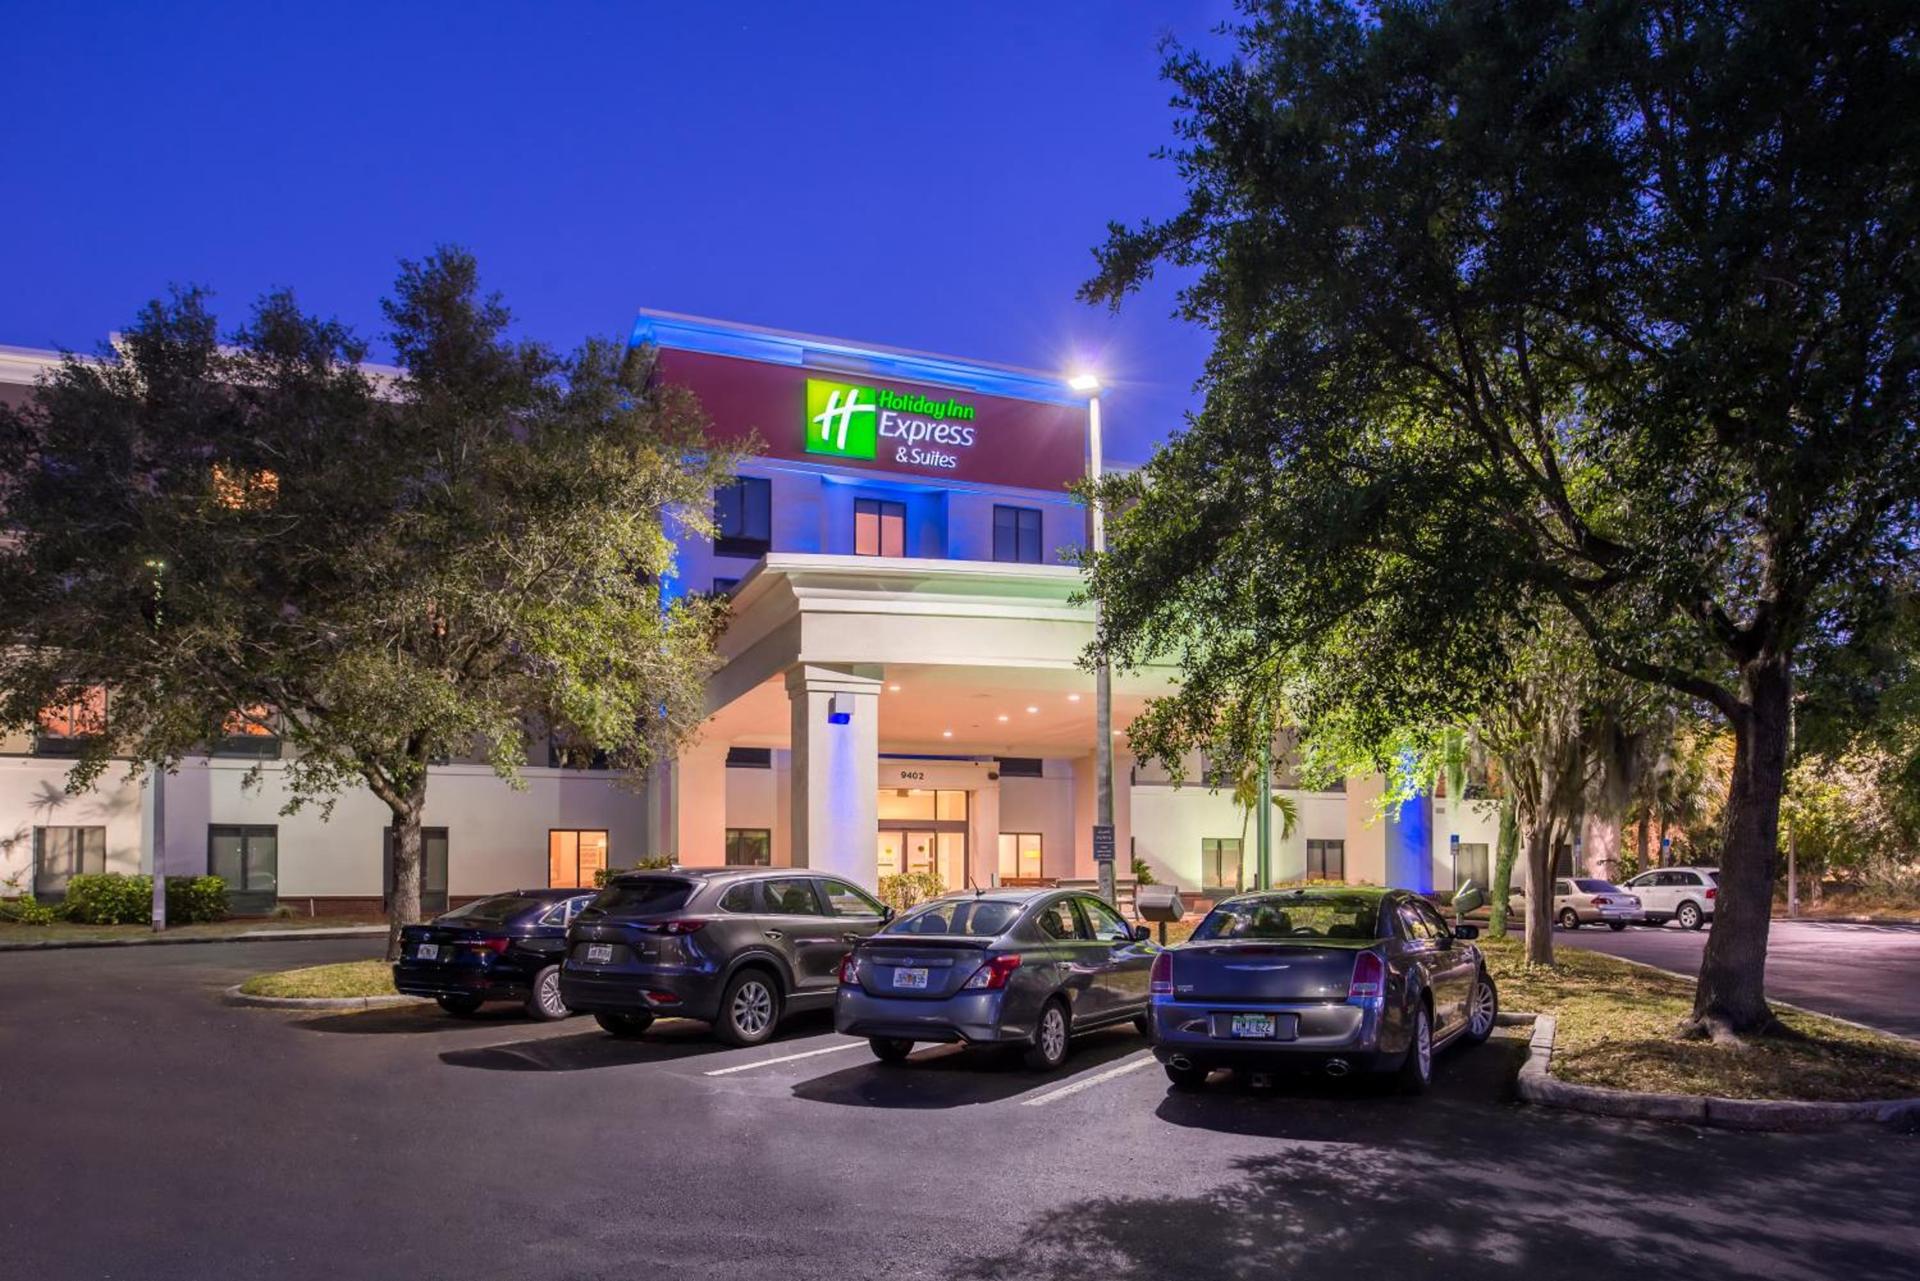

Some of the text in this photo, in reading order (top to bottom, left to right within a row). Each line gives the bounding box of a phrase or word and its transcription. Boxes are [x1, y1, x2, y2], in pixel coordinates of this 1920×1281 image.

[879, 389, 974, 420] Holiday Inn
[878, 411, 975, 446] Express
[895, 446, 957, 468] & Suites
[900, 770, 924, 780] 9402
